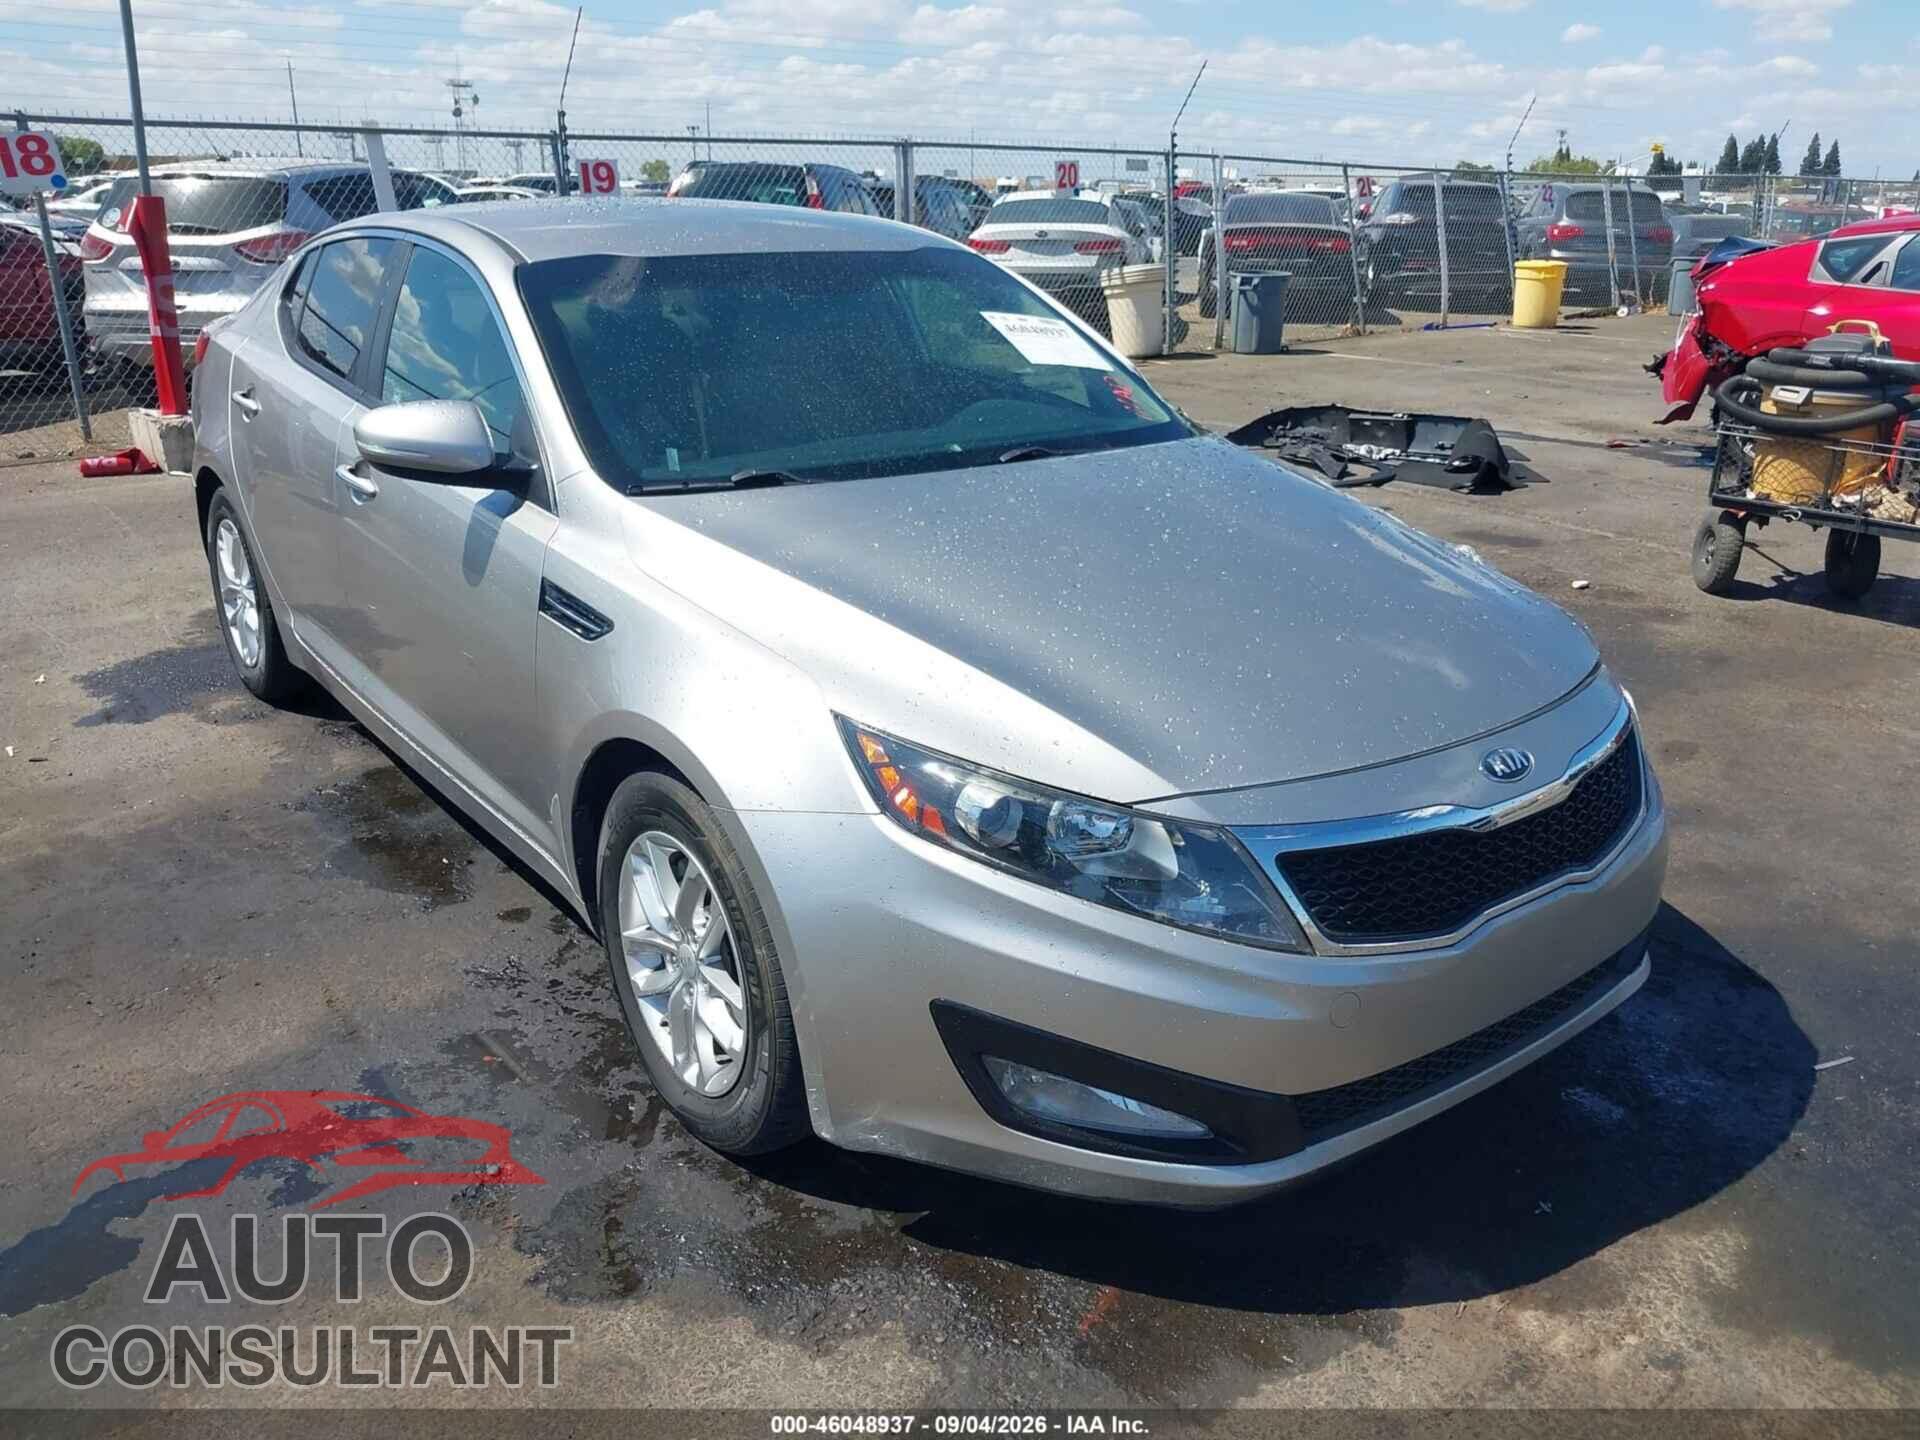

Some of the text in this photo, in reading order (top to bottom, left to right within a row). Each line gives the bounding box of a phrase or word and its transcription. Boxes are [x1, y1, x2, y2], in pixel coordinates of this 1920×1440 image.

[0, 135, 56, 178] 18
[580, 162, 615, 193] 19
[1057, 163, 1077, 188] 20
[1487, 749, 1529, 777] KIA
